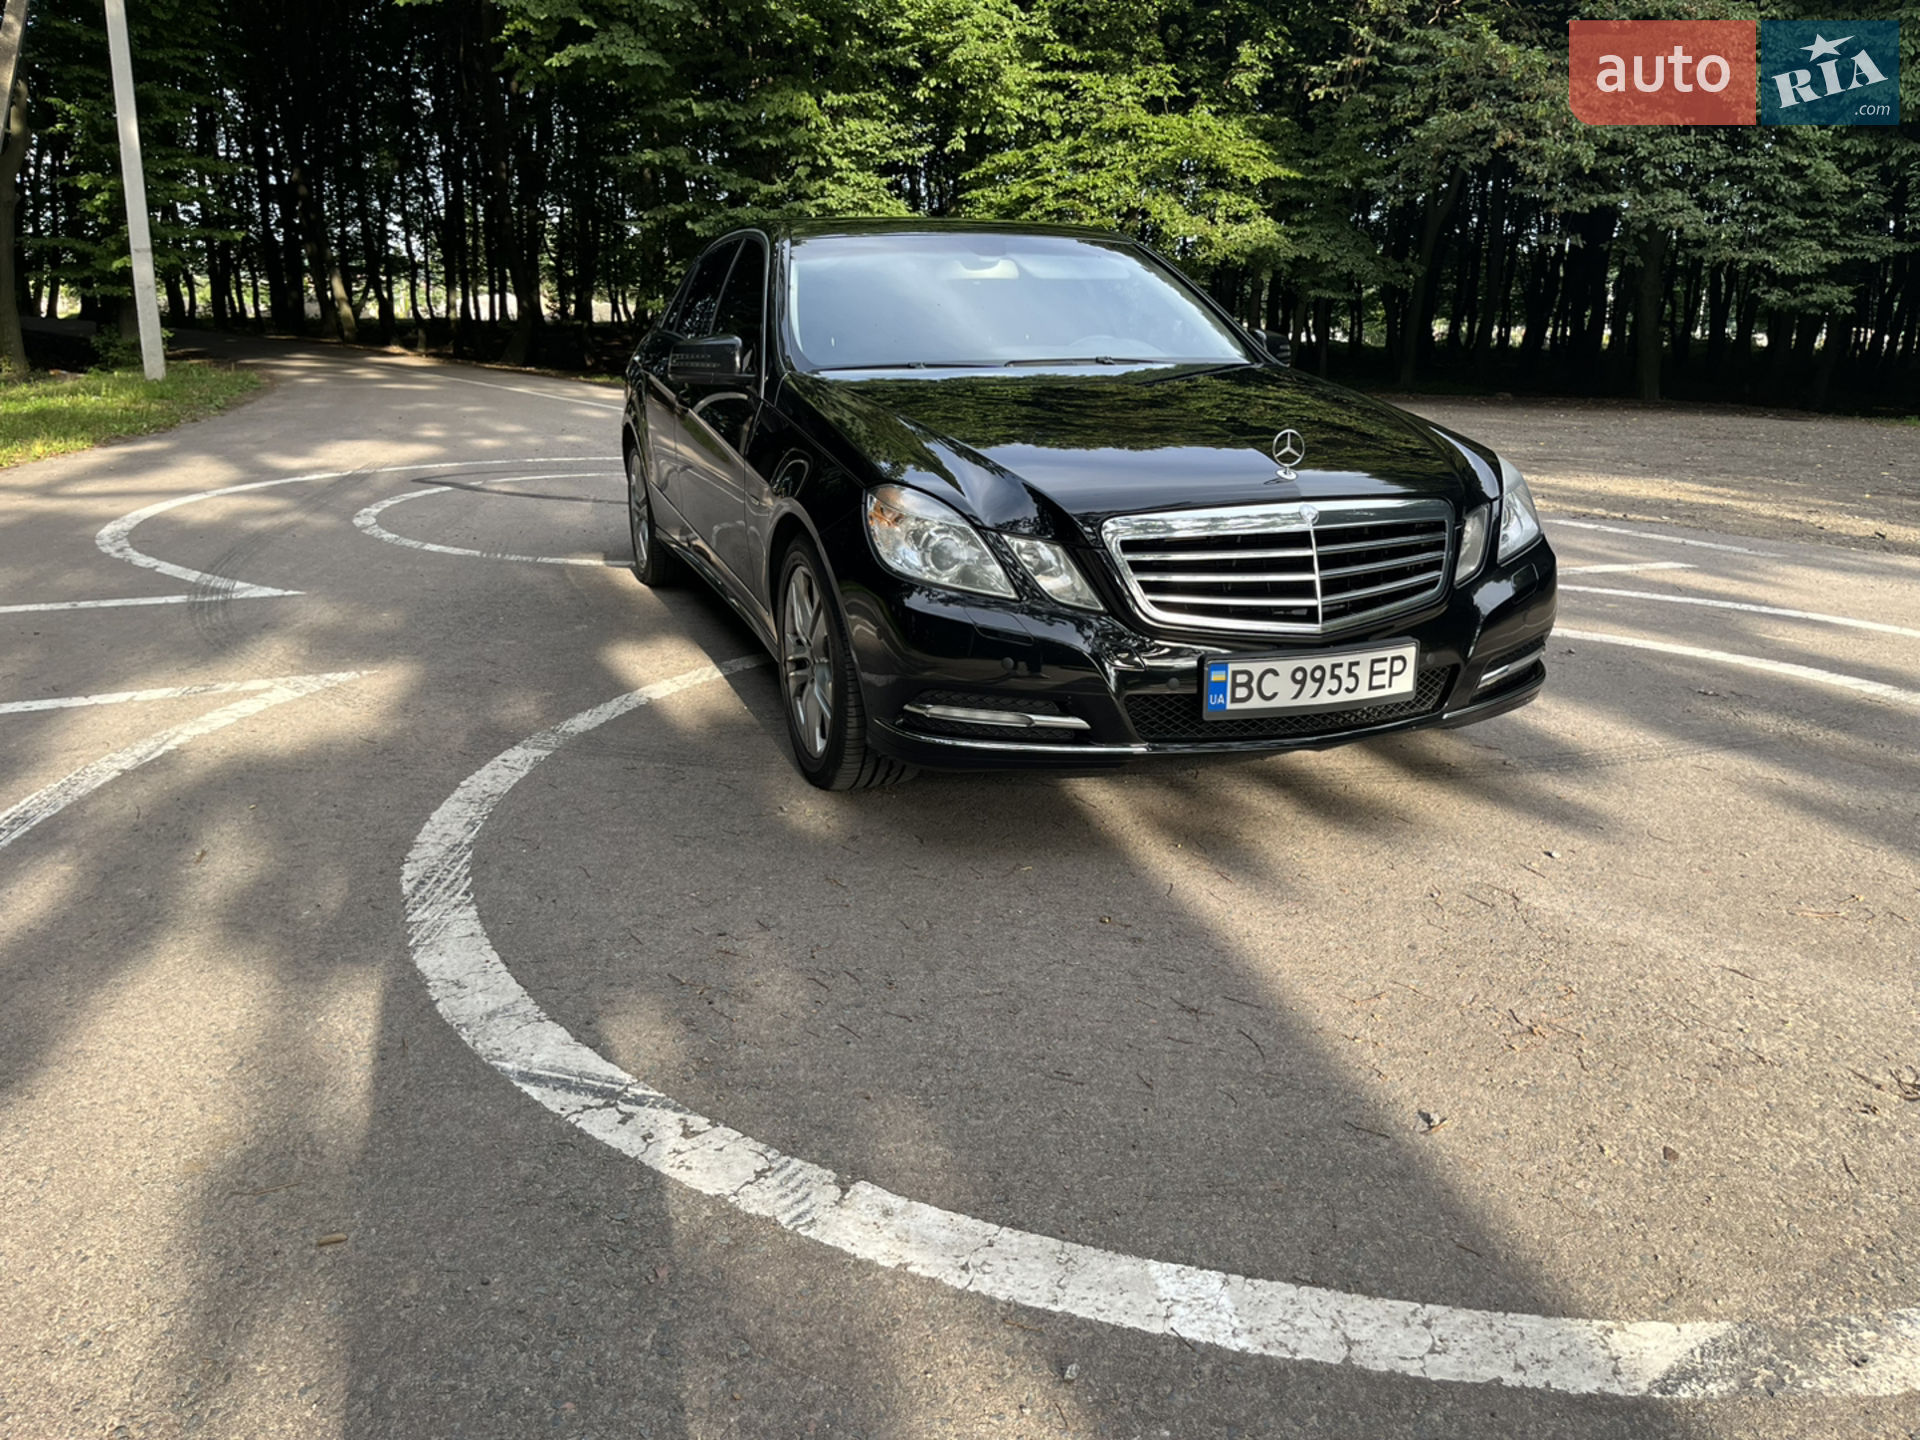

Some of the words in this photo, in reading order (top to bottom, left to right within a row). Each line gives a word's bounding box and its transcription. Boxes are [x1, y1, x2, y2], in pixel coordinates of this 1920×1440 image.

[1230, 667, 1280, 705] BC
[1290, 660, 1361, 700] 9955
[1368, 654, 1407, 692] EP
[1209, 694, 1225, 705] UA
